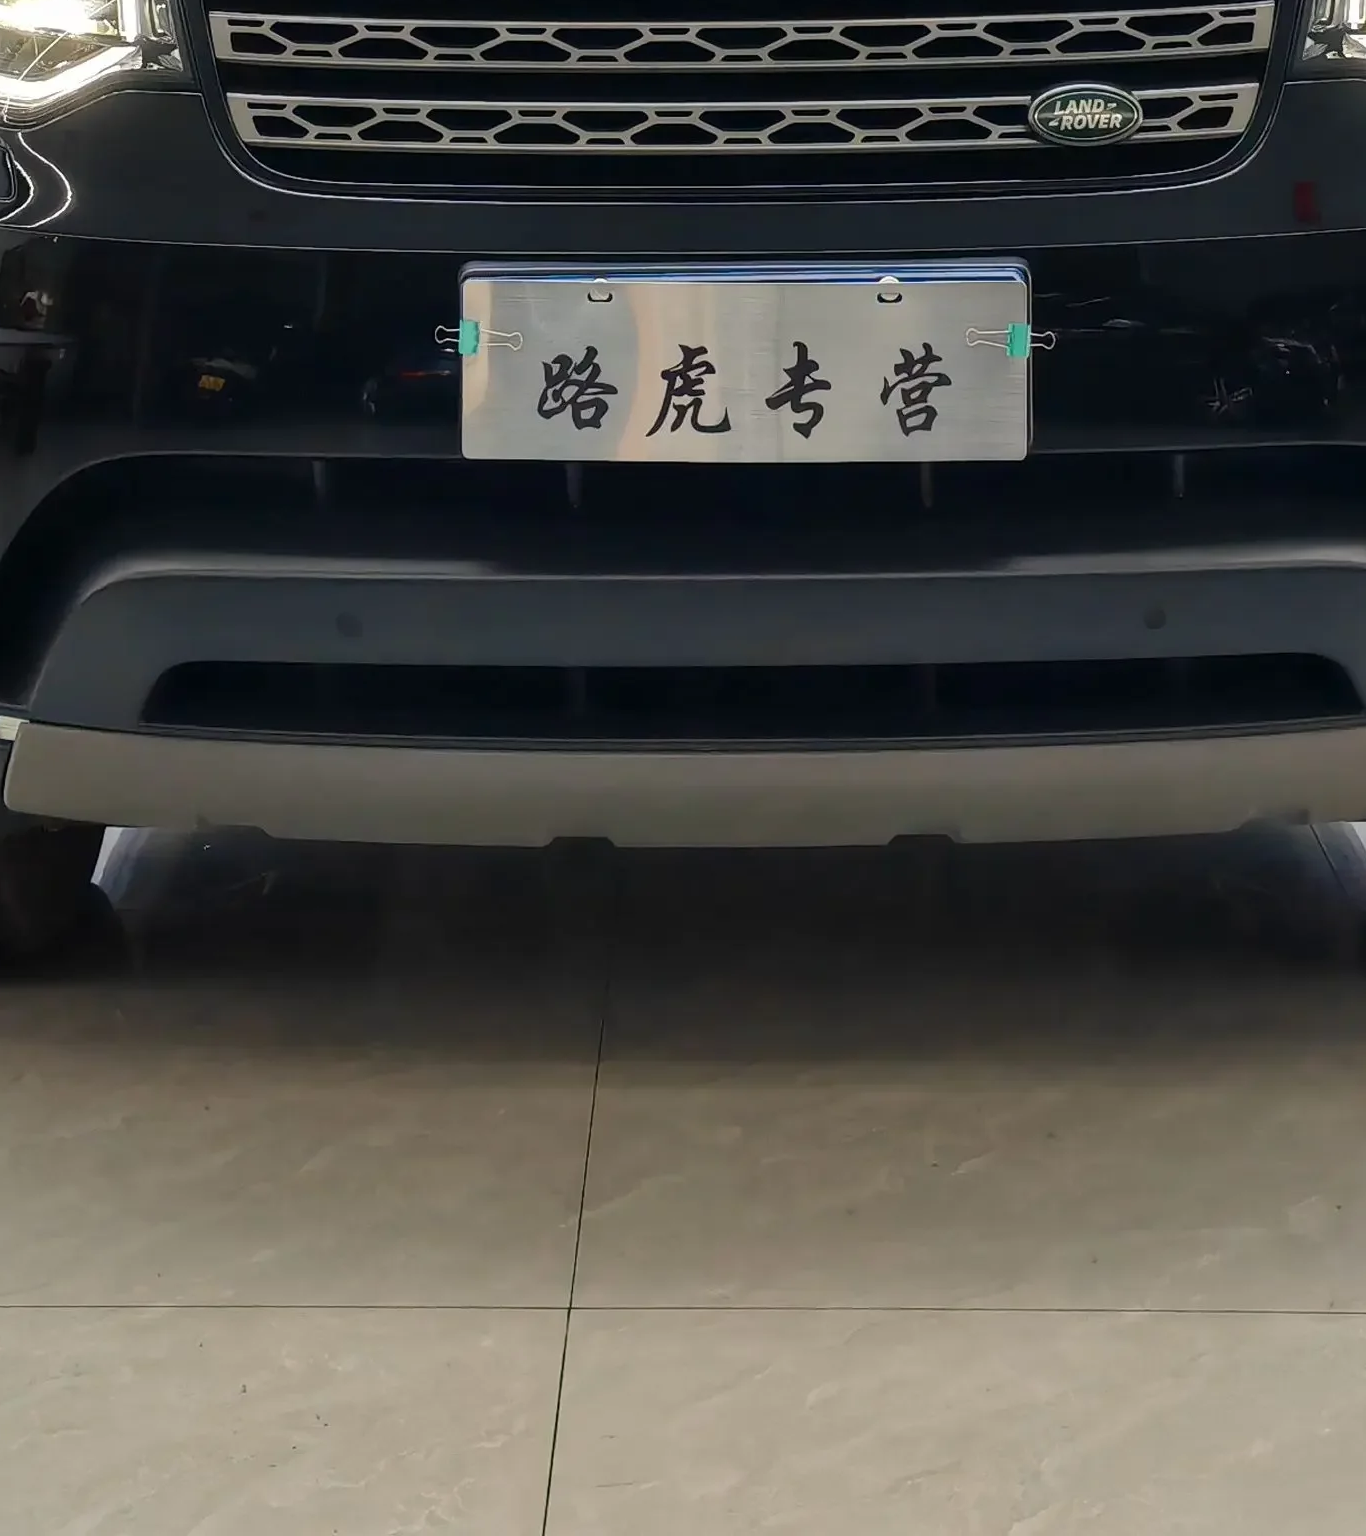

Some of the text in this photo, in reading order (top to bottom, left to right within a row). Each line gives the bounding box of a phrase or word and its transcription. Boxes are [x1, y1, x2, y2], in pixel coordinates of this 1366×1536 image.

[1054, 99, 1103, 115] LAND
[1060, 114, 1123, 131] ROVER
[536, 341, 953, 439] 路虎专营
